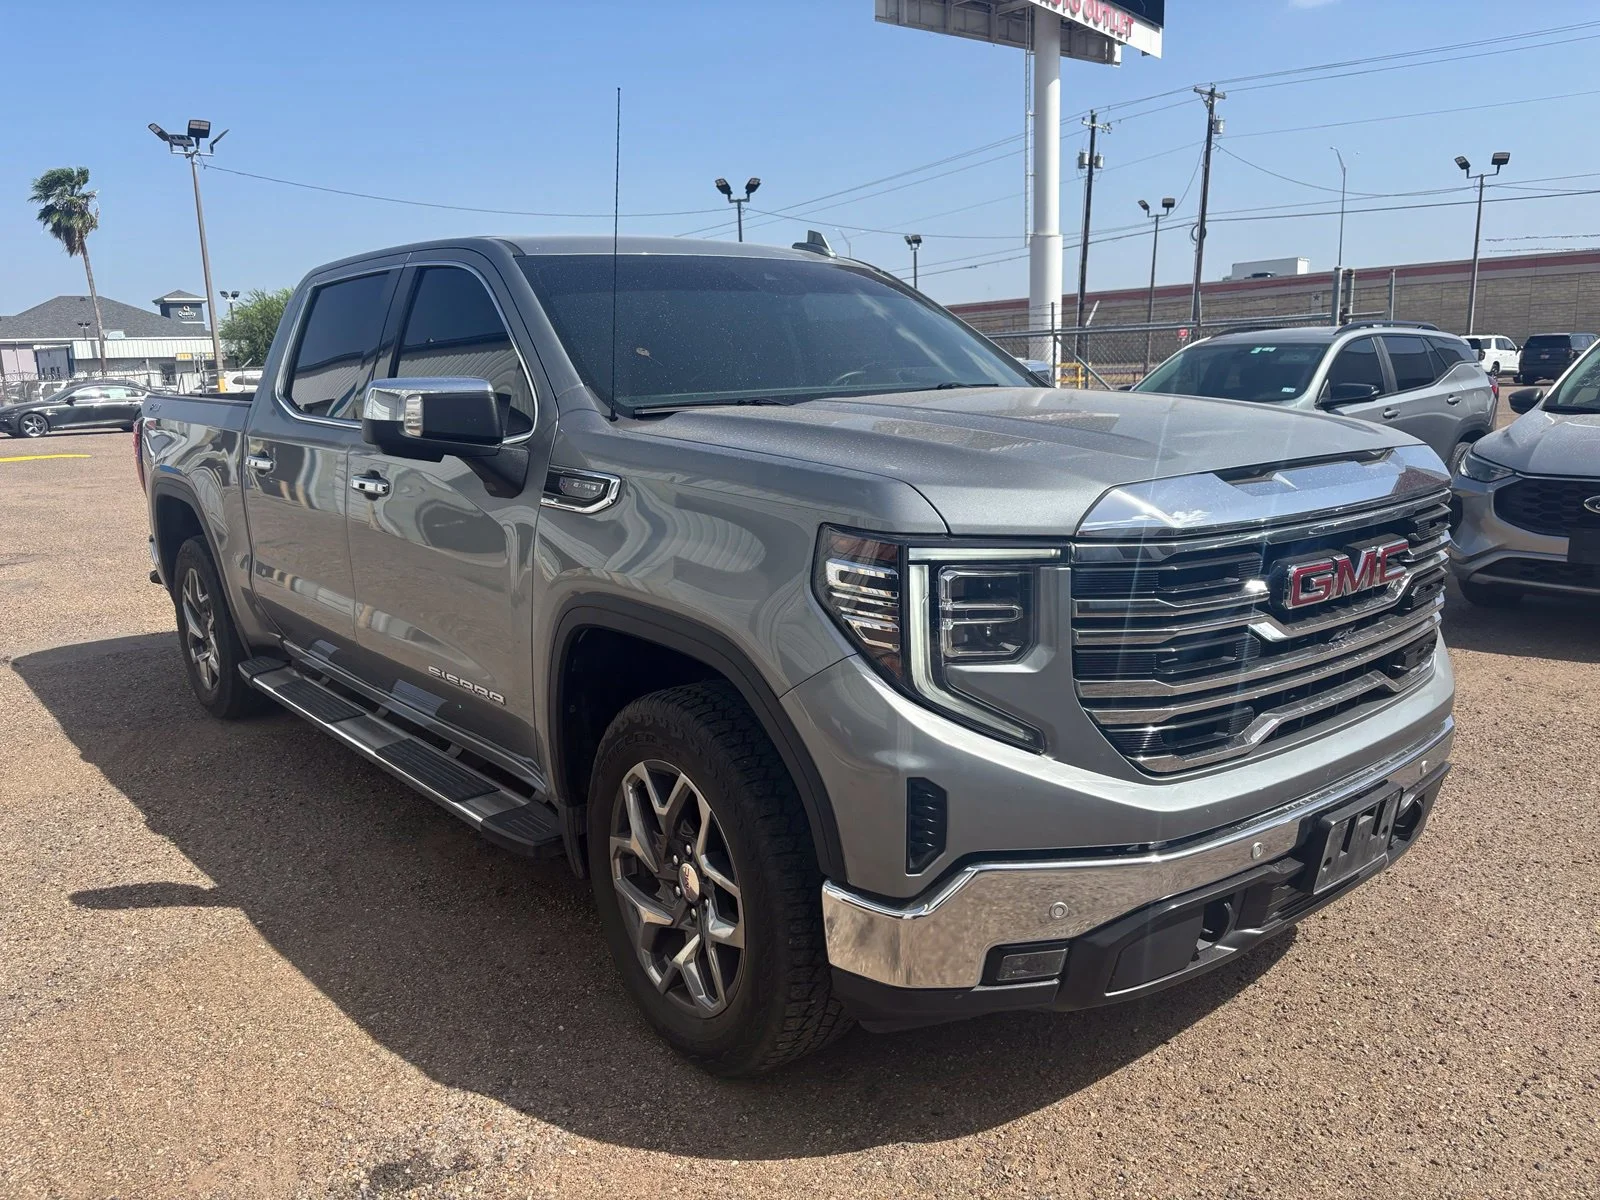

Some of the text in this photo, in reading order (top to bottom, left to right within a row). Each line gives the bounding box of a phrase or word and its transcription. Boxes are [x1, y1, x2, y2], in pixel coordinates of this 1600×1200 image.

[1082, 0, 1135, 38] OUTLET
[1286, 539, 1409, 609] GMC
[428, 665, 506, 705] SIERRA
